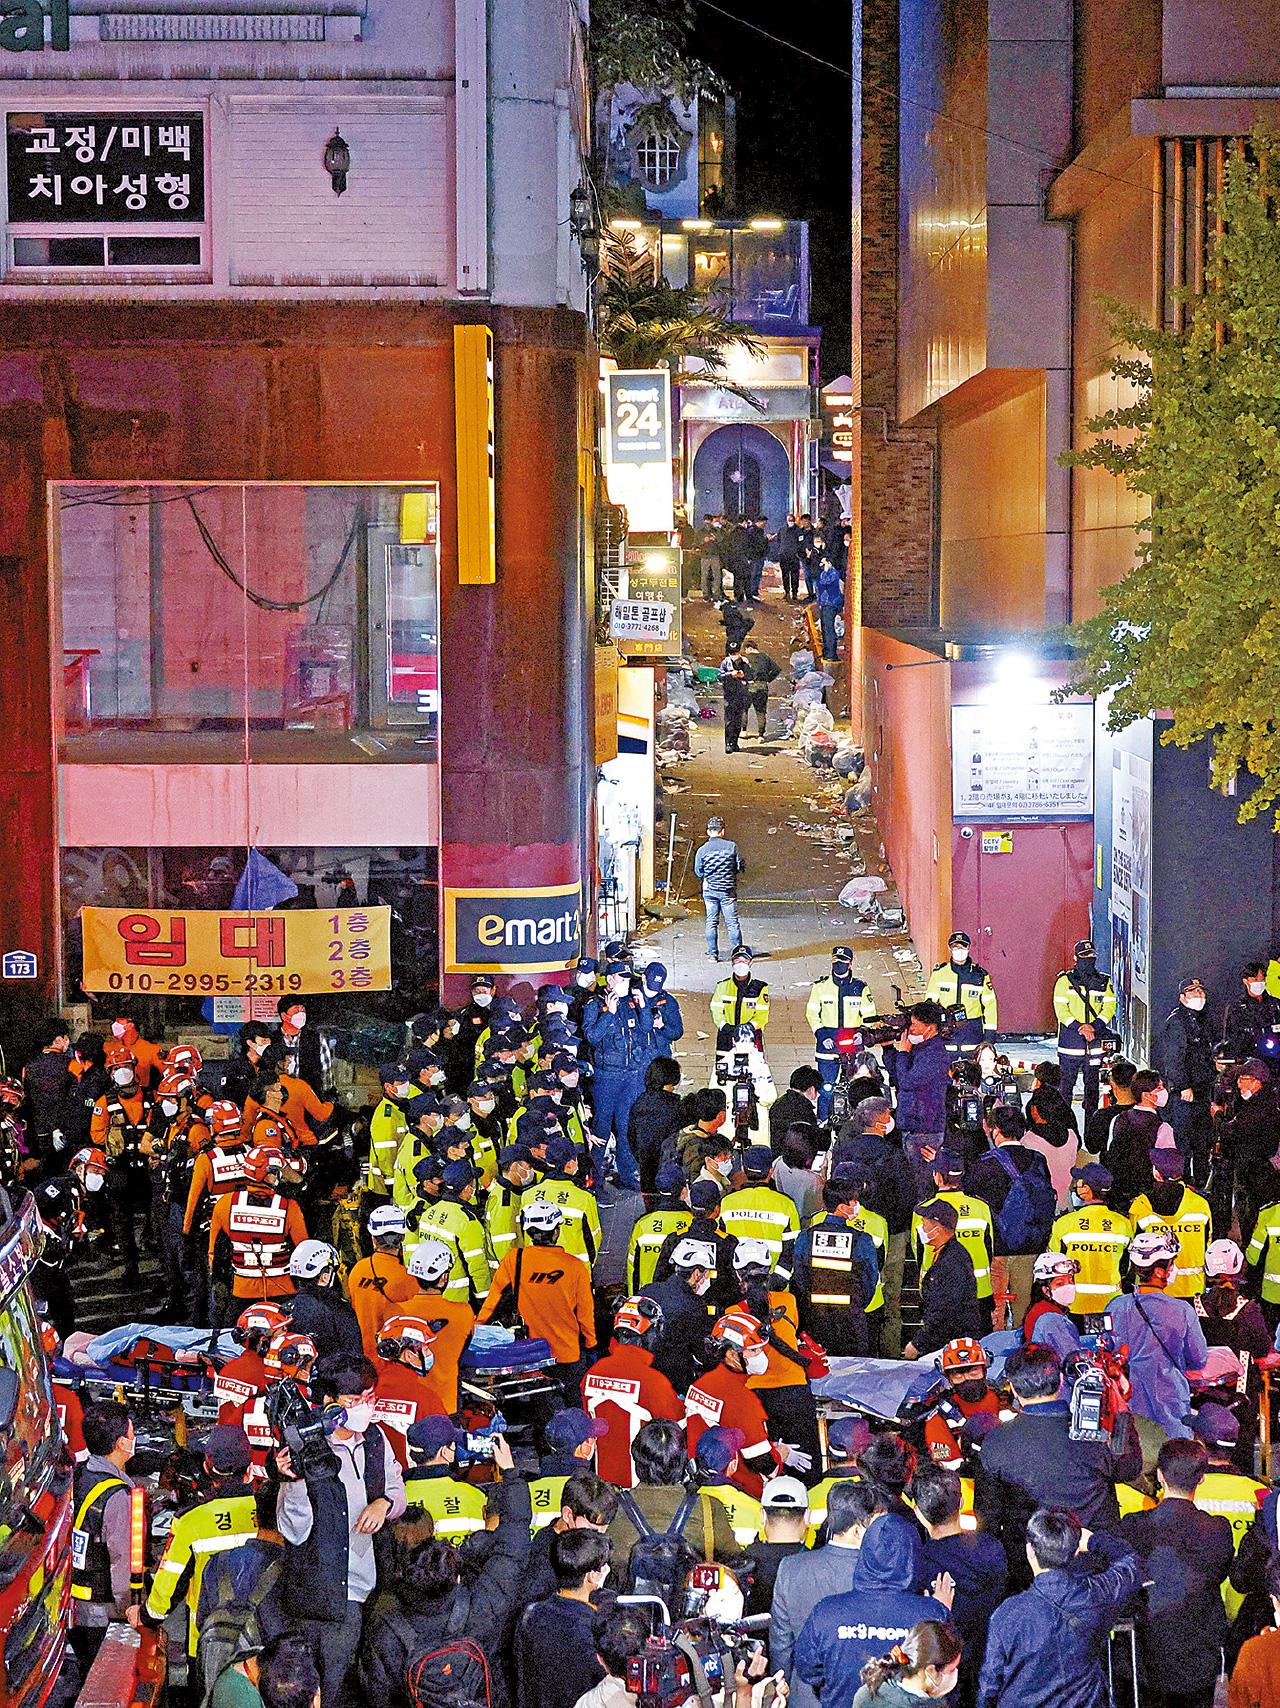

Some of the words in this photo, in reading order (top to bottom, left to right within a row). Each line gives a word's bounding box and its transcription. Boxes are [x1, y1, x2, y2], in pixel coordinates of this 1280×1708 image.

[25, 125, 191, 163] 교정/미백
[28, 172, 191, 211] 치아성형
[616, 402, 662, 438] 24
[614, 605, 639, 621] 해밀톤
[641, 607, 667, 624] 골프샵
[327, 912, 371, 936] 1층
[328, 938, 371, 962] 2층
[10, 963, 31, 975] 173
[330, 966, 373, 989] 3층
[108, 972, 303, 992] 010-2995-2319
[731, 1211, 774, 1221] POLICE
[1152, 1224, 1201, 1233] POLICE
[1071, 1243, 1119, 1253] POLICE
[527, 1269, 565, 1286] 119
[376, 1398, 408, 1415] 구조대
